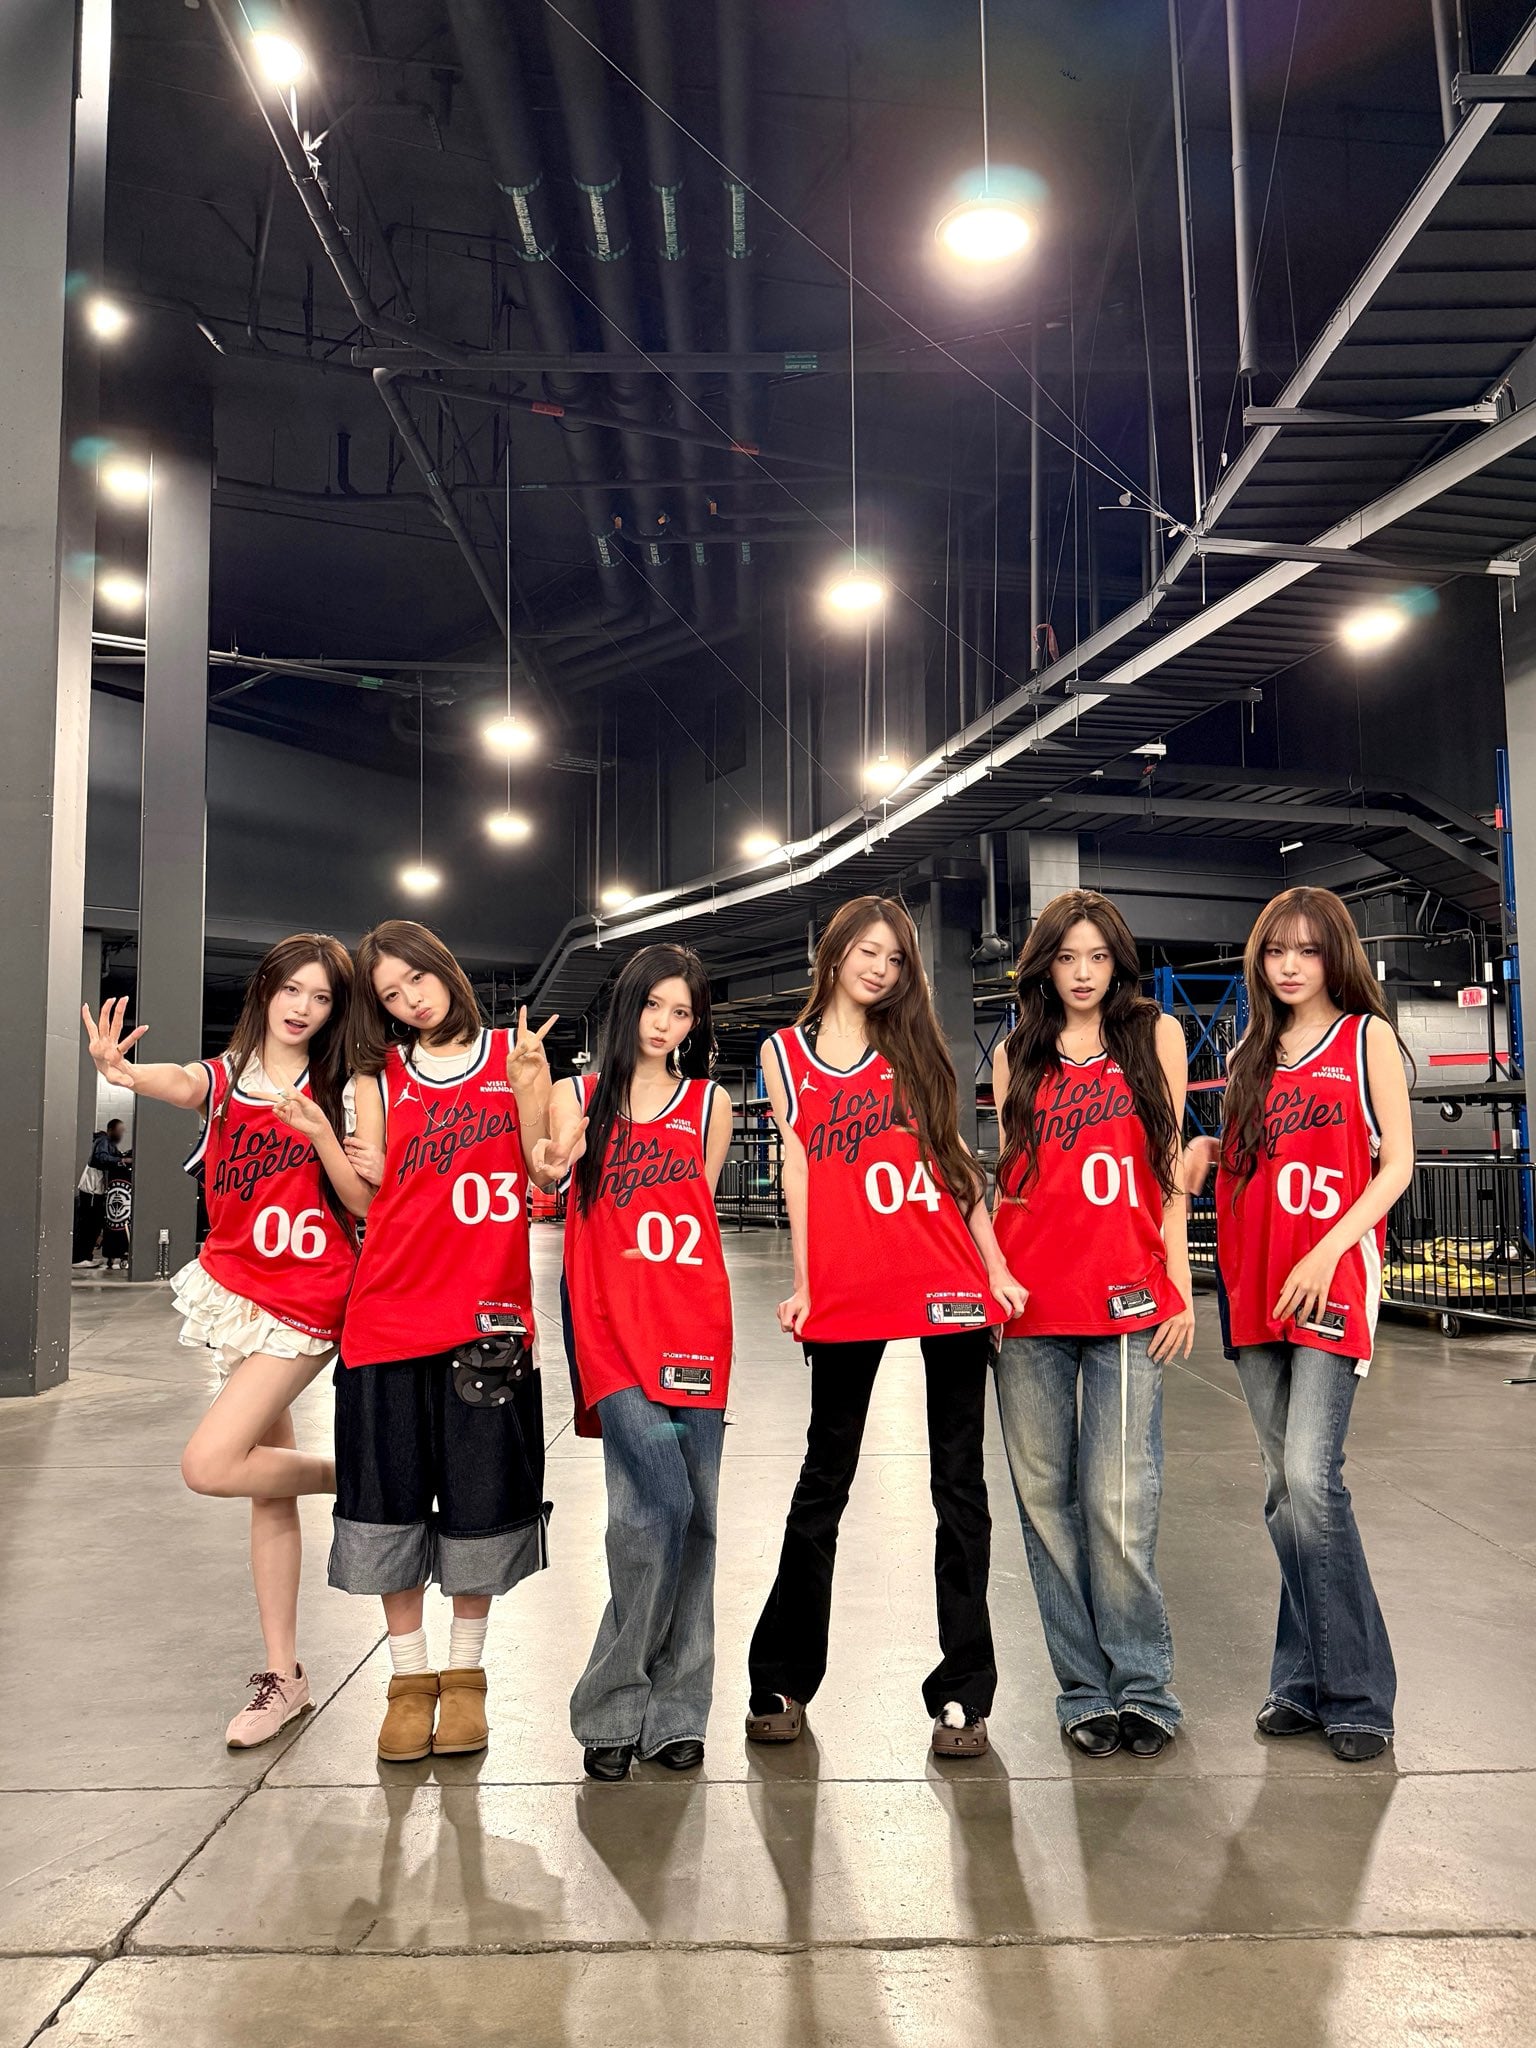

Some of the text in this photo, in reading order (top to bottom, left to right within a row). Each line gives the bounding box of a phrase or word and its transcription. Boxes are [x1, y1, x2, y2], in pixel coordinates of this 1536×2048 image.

[522, 235, 538, 254] CHILLED
[597, 233, 611, 254] CHILLED
[1050, 1077, 1105, 1112] Los
[1312, 1072, 1352, 1082] RWANDA
[423, 1101, 478, 1138] Los
[665, 1123, 697, 1135] RWANDA
[672, 1118, 691, 1127] VISIT
[829, 1089, 880, 1127] Los
[1033, 1086, 1138, 1151] Angele
[229, 1123, 281, 1163] Los
[398, 1111, 516, 1186] Angeles
[606, 1130, 664, 1168] Los
[213, 1136, 319, 1201] Angeles
[597, 1148, 700, 1208] ngeles
[864, 1161, 941, 1215] 04
[1081, 1152, 1139, 1208] 01
[1277, 1161, 1344, 1220] 05
[452, 1172, 520, 1225] 03
[253, 1206, 327, 1259] 06
[636, 1211, 703, 1266] 02
